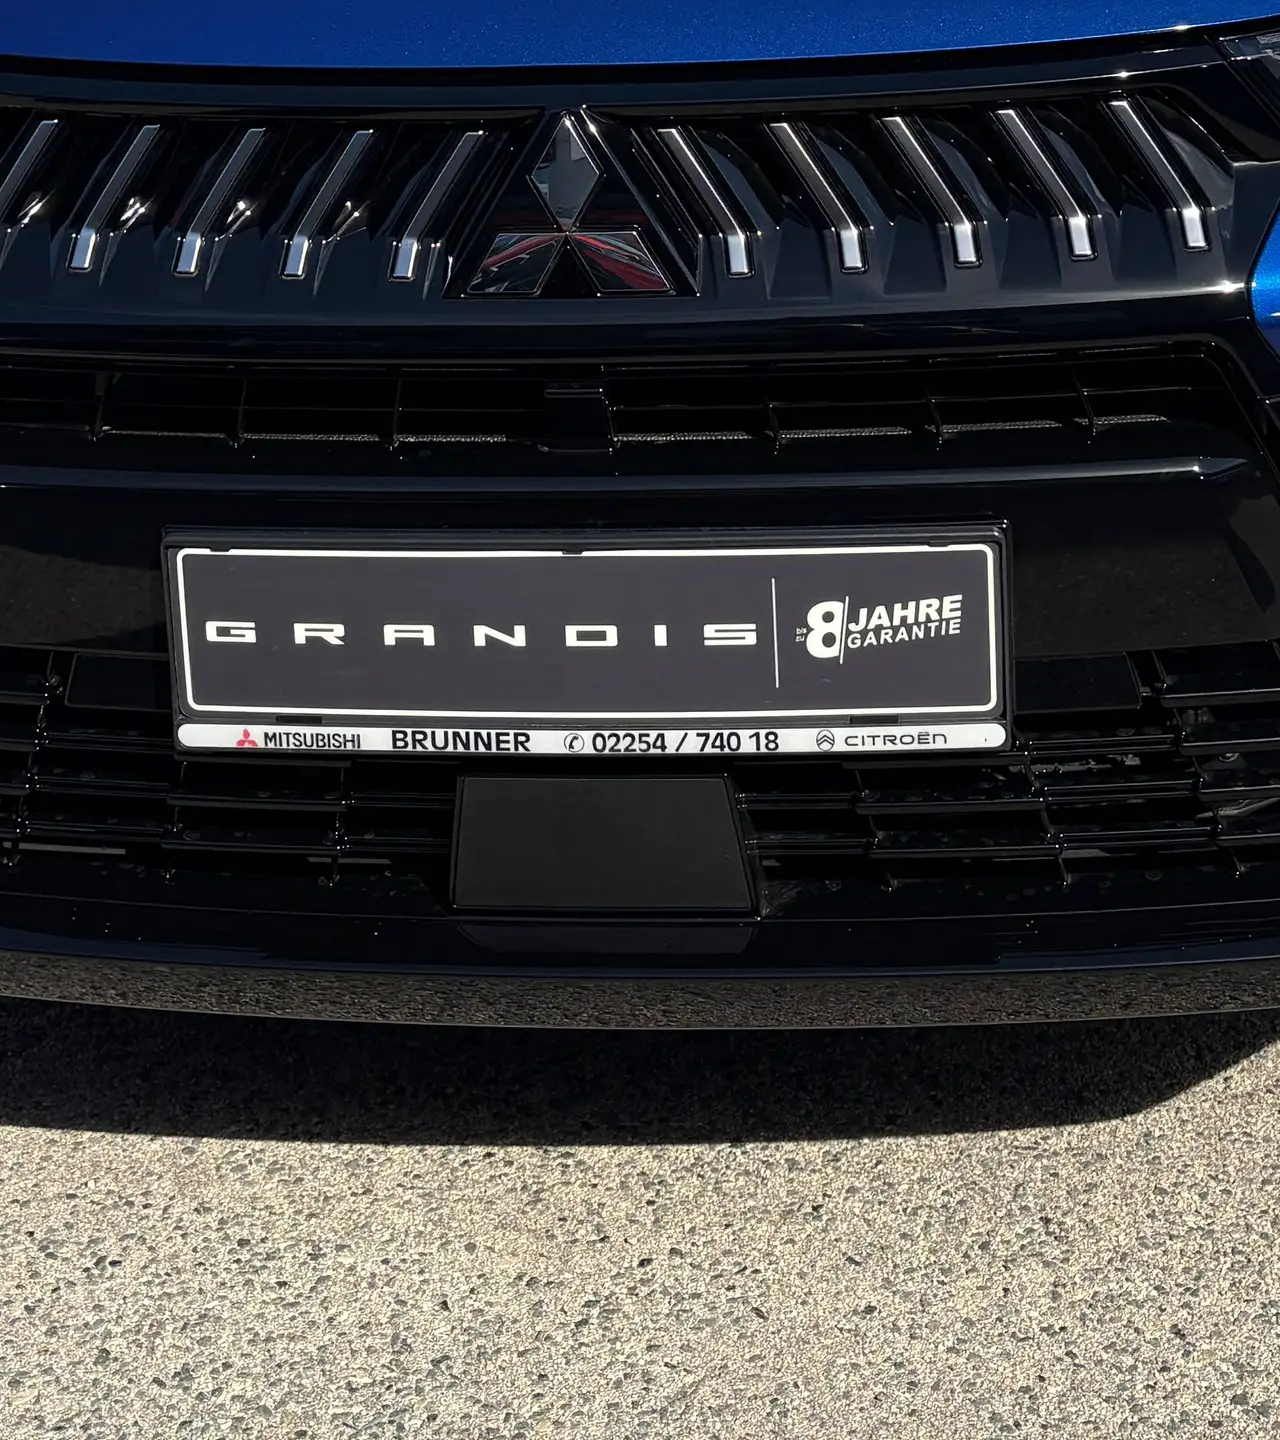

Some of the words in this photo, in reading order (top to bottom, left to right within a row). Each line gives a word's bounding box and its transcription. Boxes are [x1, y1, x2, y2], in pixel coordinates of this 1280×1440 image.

[205, 620, 757, 647] GRANDIS
[806, 601, 844, 659] 8
[848, 594, 963, 632] JAHRE
[847, 619, 962, 649] GARANTIE
[263, 731, 361, 749] MITSUBISHI
[391, 729, 531, 752] BRUNNER
[591, 732, 668, 752] 02254
[675, 732, 689, 752] /
[695, 732, 741, 752] 740
[749, 731, 780, 752] 18
